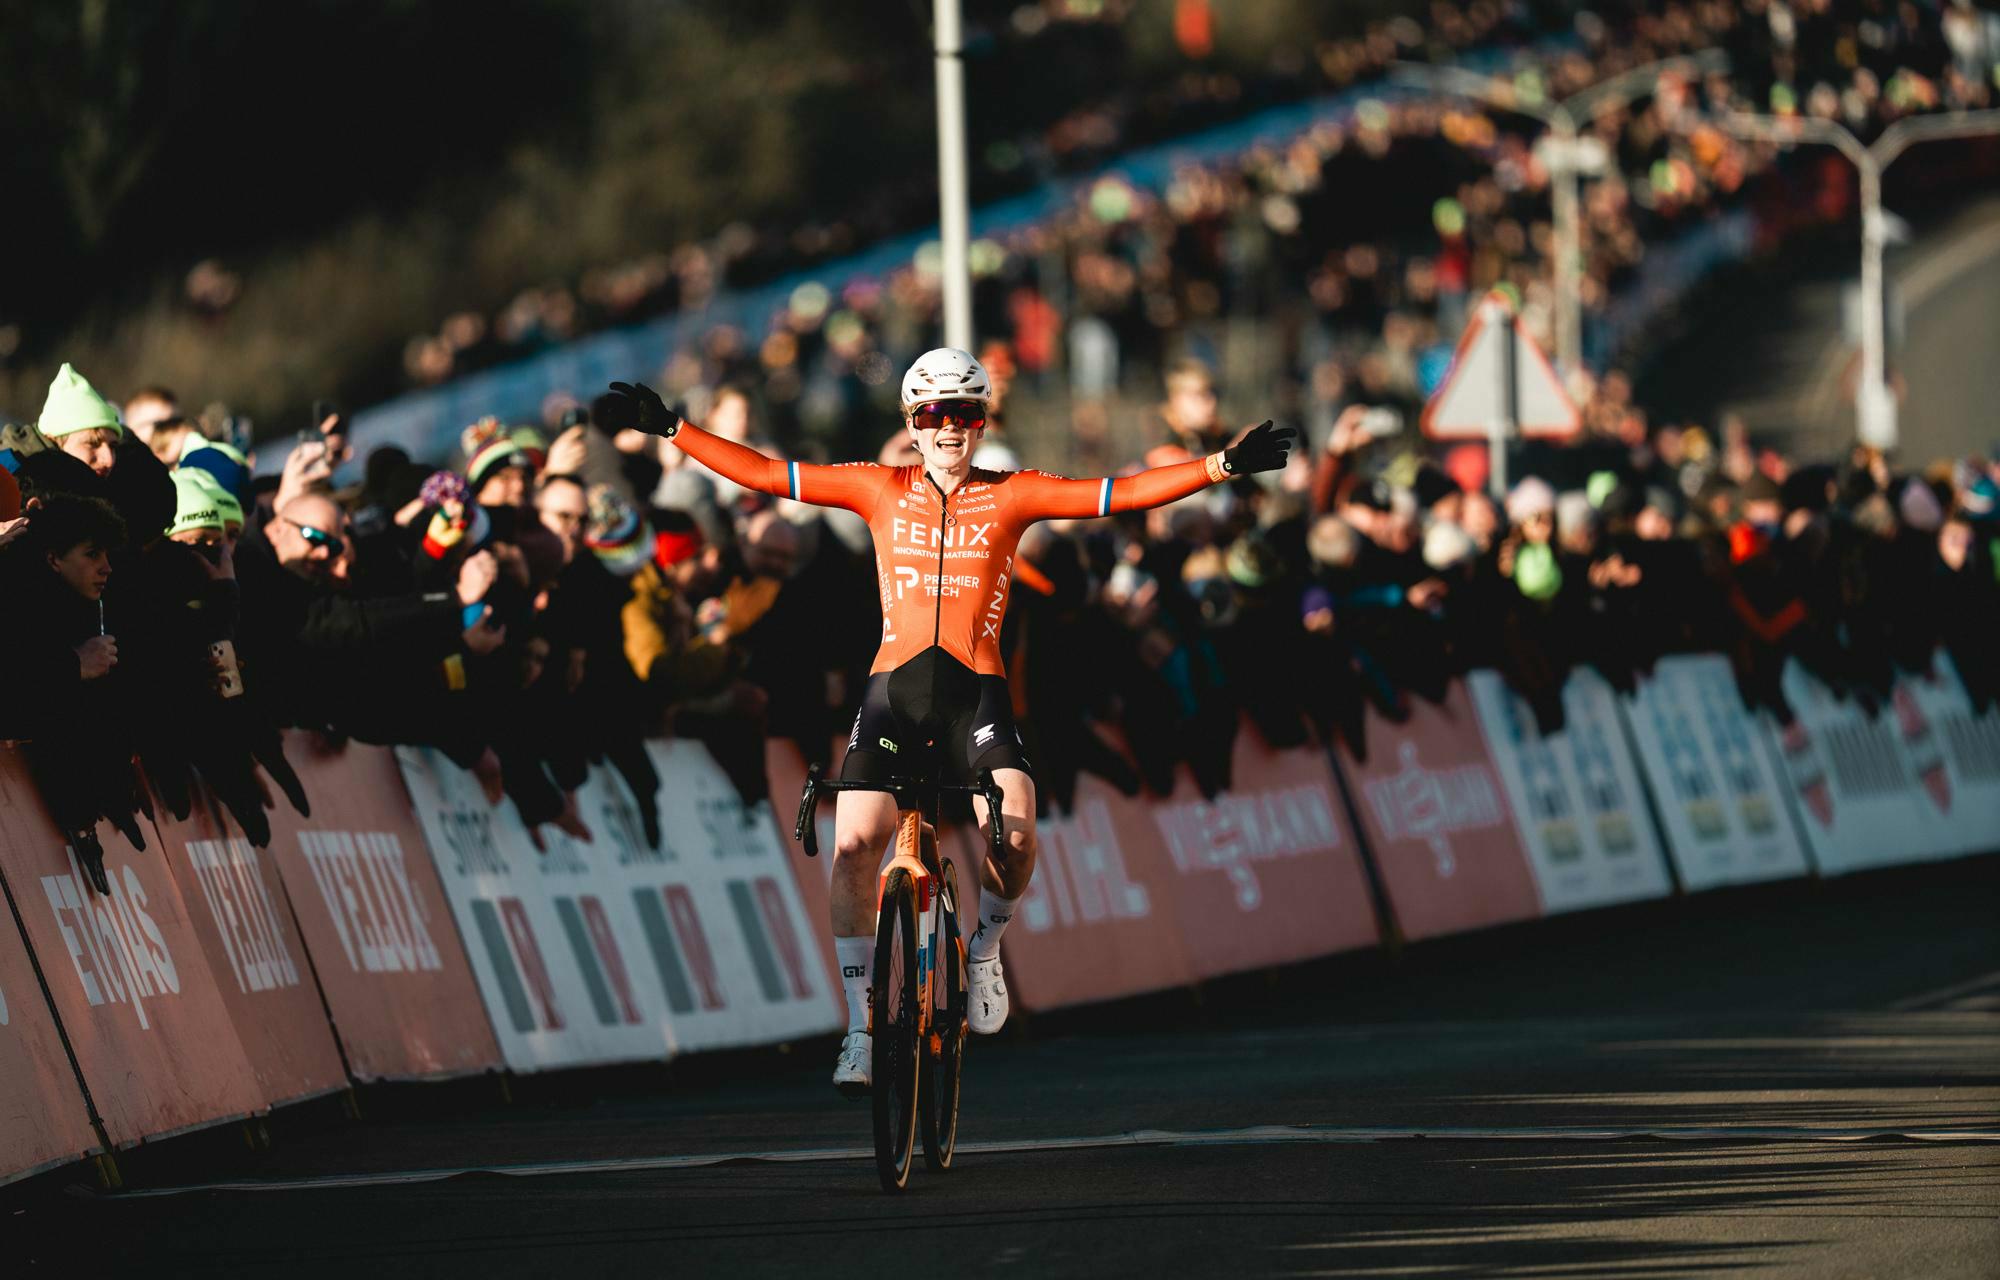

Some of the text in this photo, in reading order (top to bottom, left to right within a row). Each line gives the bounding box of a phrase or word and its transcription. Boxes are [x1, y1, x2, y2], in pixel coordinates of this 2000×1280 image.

[893, 517, 992, 548] FENIX
[893, 546, 990, 560] INNOVATIVE MATERIALS
[923, 574, 980, 589] PREMIER
[924, 585, 960, 598] TECH
[982, 555, 1012, 638] FENIX
[185, 837, 301, 994] VELUX
[297, 830, 443, 973] VELUX
